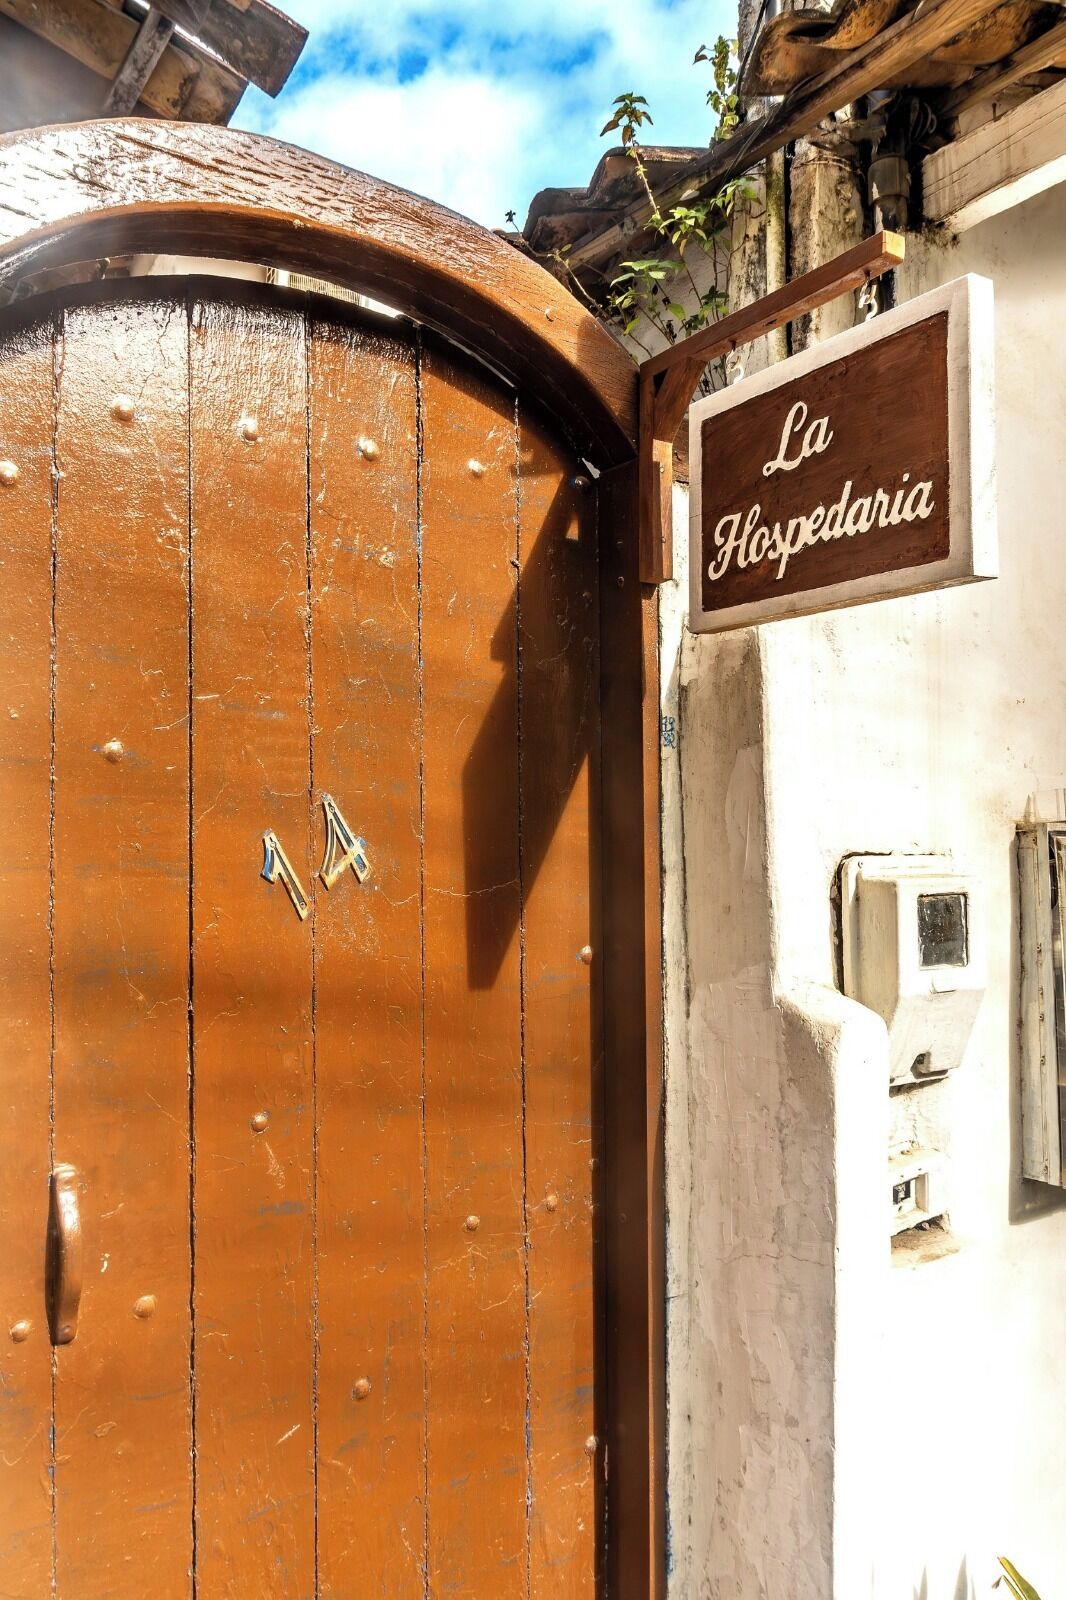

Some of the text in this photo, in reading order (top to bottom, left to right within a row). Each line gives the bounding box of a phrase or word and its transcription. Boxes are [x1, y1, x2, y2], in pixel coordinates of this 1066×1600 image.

[762, 401, 833, 477] La
[708, 473, 935, 581] Hospedaria
[260, 793, 371, 922] 14
